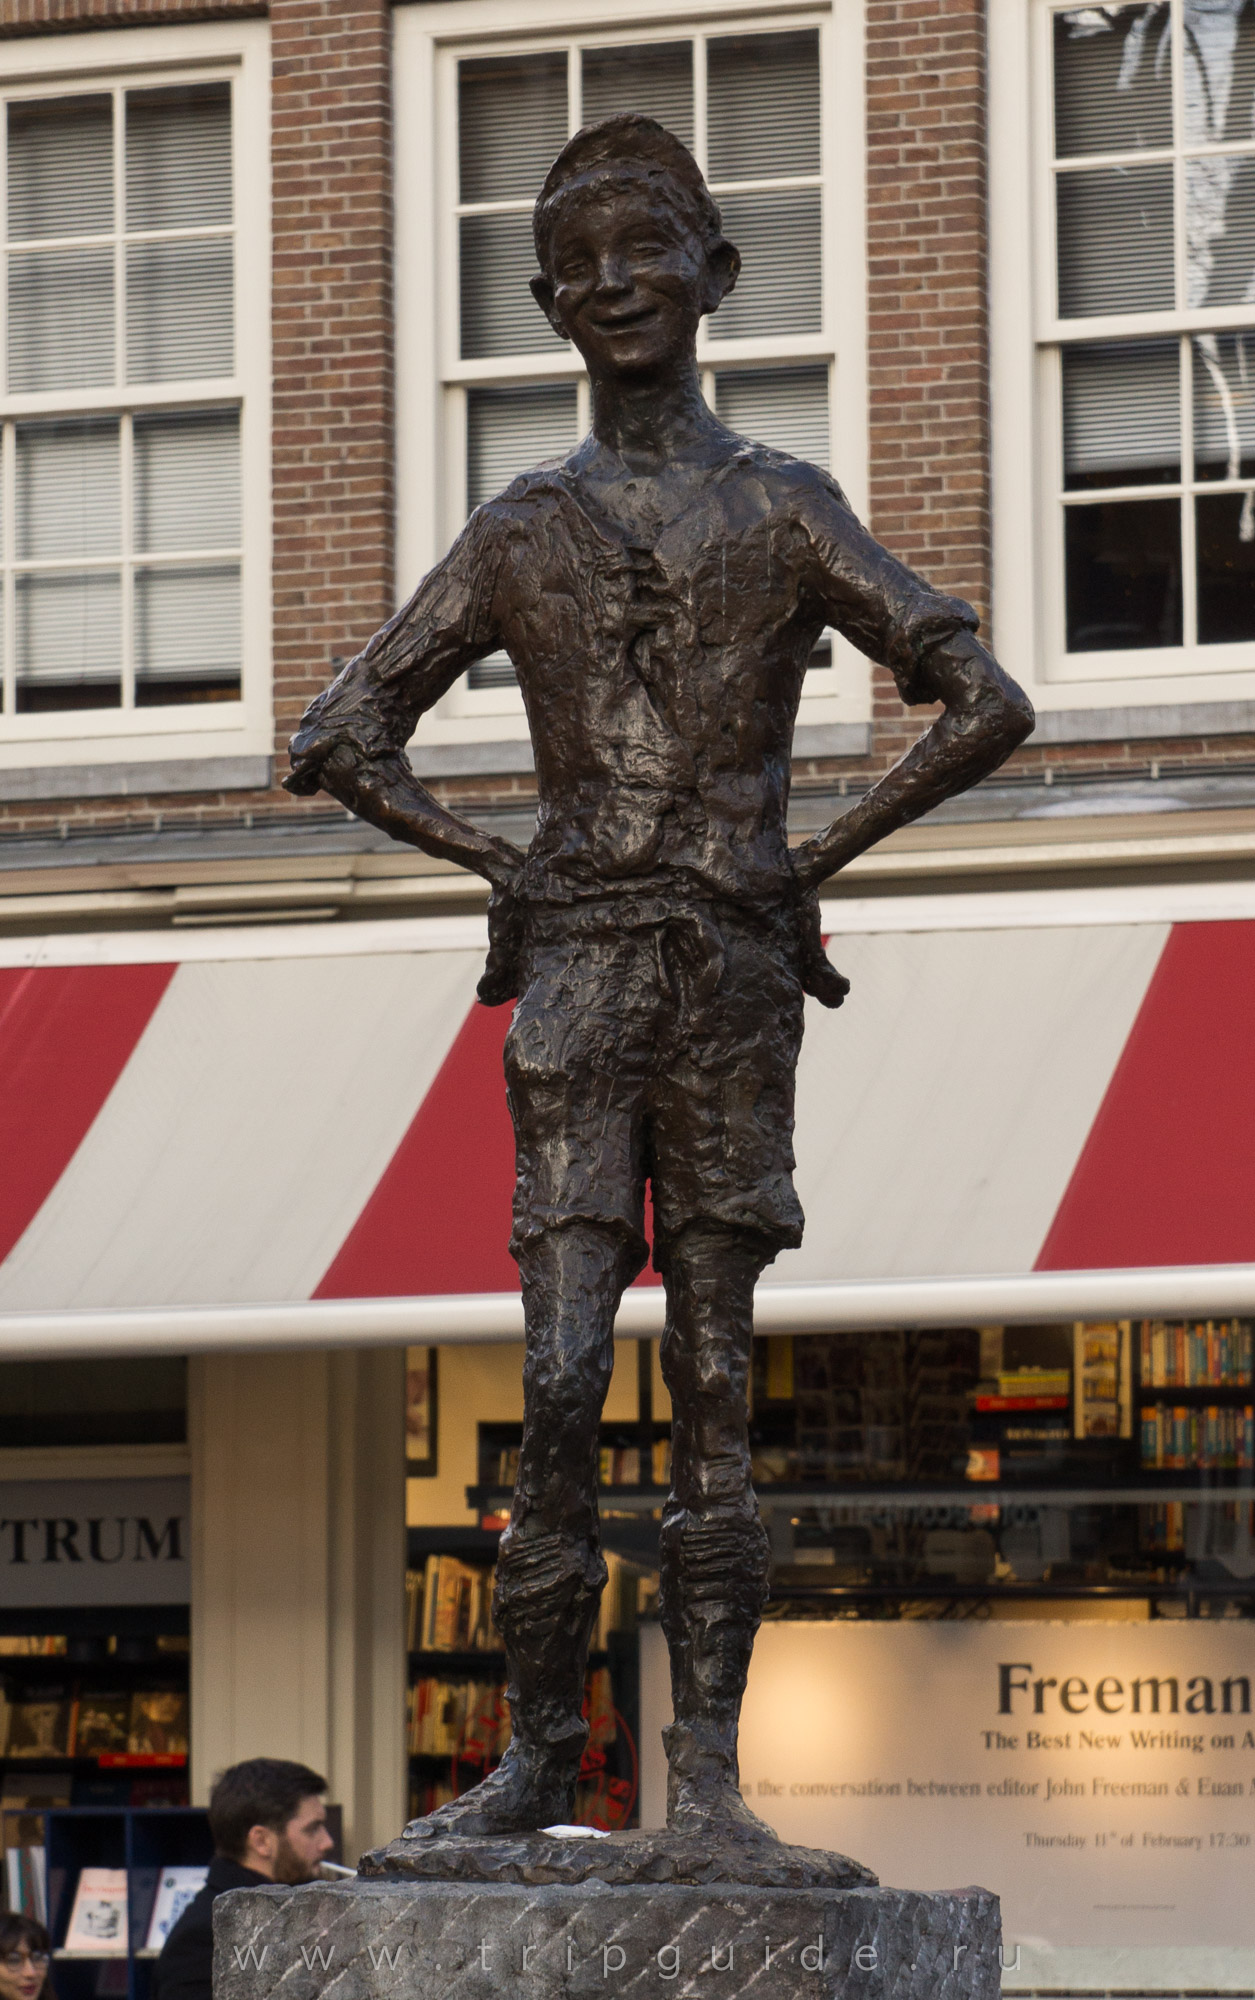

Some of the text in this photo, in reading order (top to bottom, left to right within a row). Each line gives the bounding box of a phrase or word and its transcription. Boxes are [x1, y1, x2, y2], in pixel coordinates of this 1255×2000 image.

[0, 1517, 184, 1563] TRUM
[998, 1662, 1252, 1715] Freeman
[981, 1730, 1019, 1749] The
[1027, 1730, 1071, 1749] Best
[1079, 1730, 1121, 1749] New
[1130, 1730, 1204, 1753] Writing
[1210, 1734, 1235, 1749] on
[757, 1778, 785, 1796] the
[789, 1778, 901, 1796] conversation
[906, 1777, 981, 1796] between
[986, 1777, 1039, 1796] editor
[1045, 1777, 1085, 1801] John
[1092, 1777, 1169, 1796] Freeman
[1175, 1777, 1189, 1796] &
[1197, 1777, 1244, 1796] Euan
[1024, 1832, 1086, 1848] Thursday
[1120, 1832, 1134, 1847] of
[1142, 1832, 1202, 1851] February
